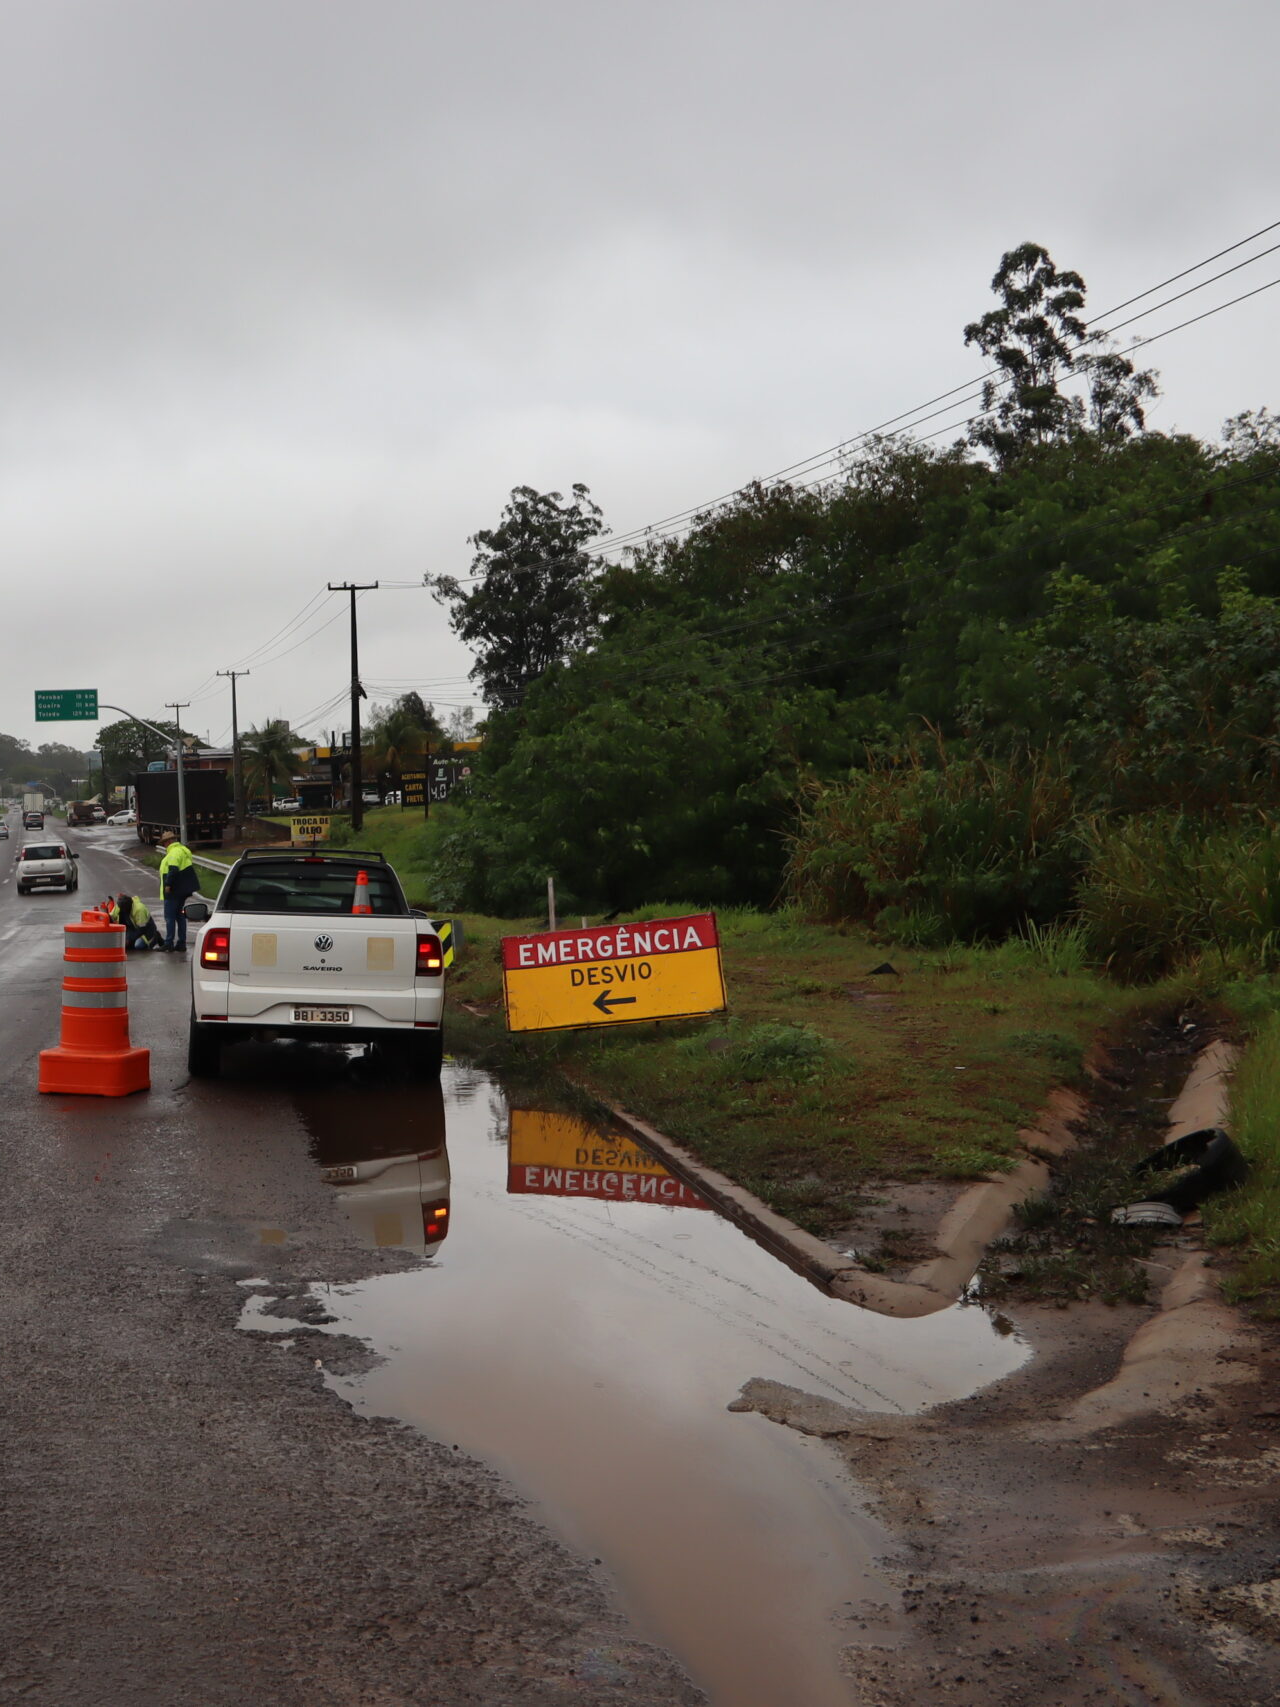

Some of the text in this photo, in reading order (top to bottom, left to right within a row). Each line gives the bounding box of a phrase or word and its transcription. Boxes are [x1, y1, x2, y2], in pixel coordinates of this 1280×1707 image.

[404, 783, 423, 791] CARTA
[406, 794, 424, 803] FRETE
[292, 818, 318, 826] TROCA
[519, 926, 702, 966] EMERGÊNCIA
[570, 961, 652, 986] DESVIO
